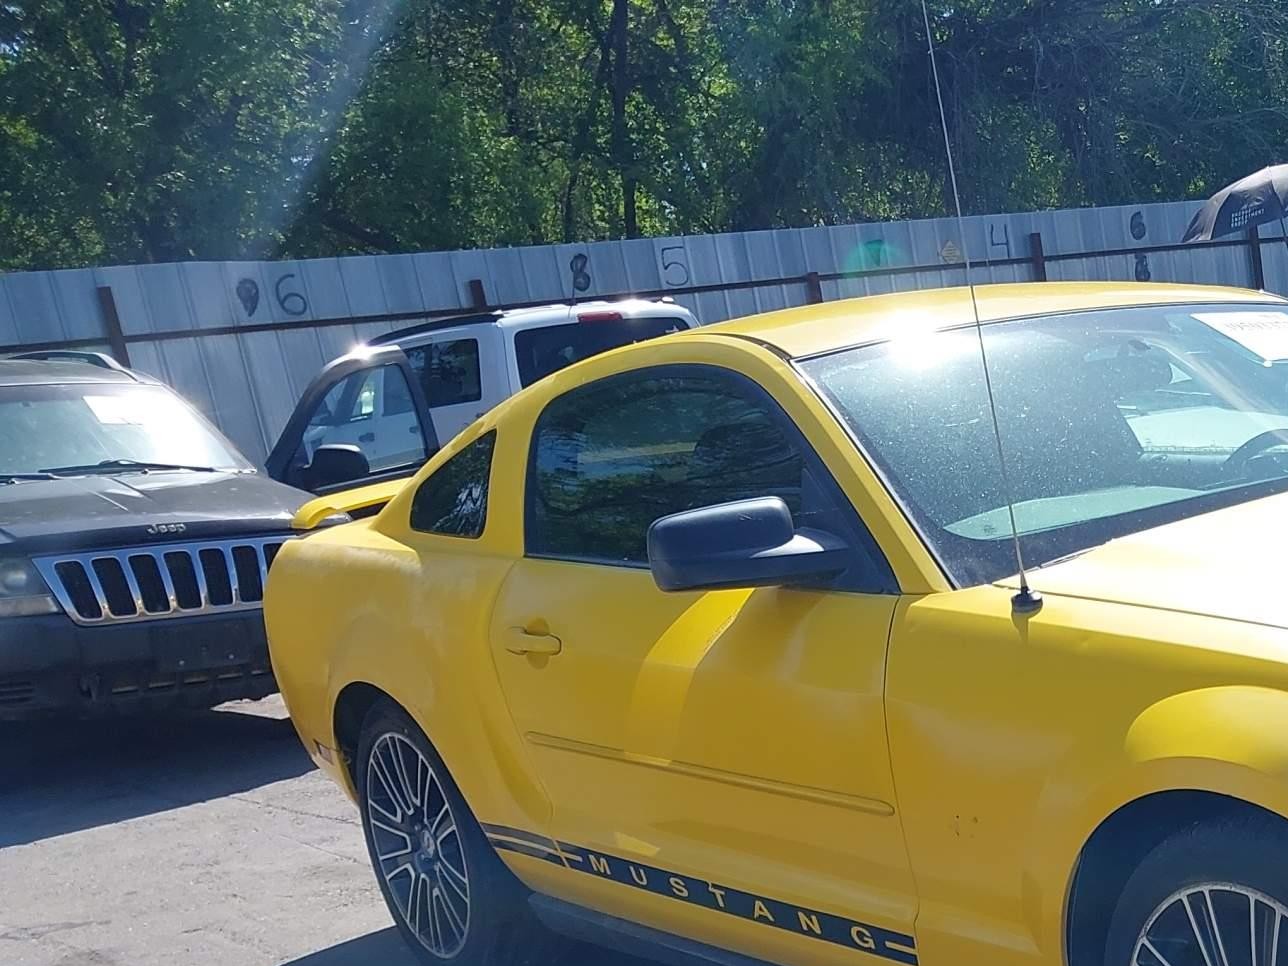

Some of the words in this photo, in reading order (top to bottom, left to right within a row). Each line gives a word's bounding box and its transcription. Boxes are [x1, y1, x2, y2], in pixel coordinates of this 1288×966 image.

[660, 245, 689, 287] 5
[147, 523, 186, 535] Jeep
[589, 853, 877, 950] MUSTANG
